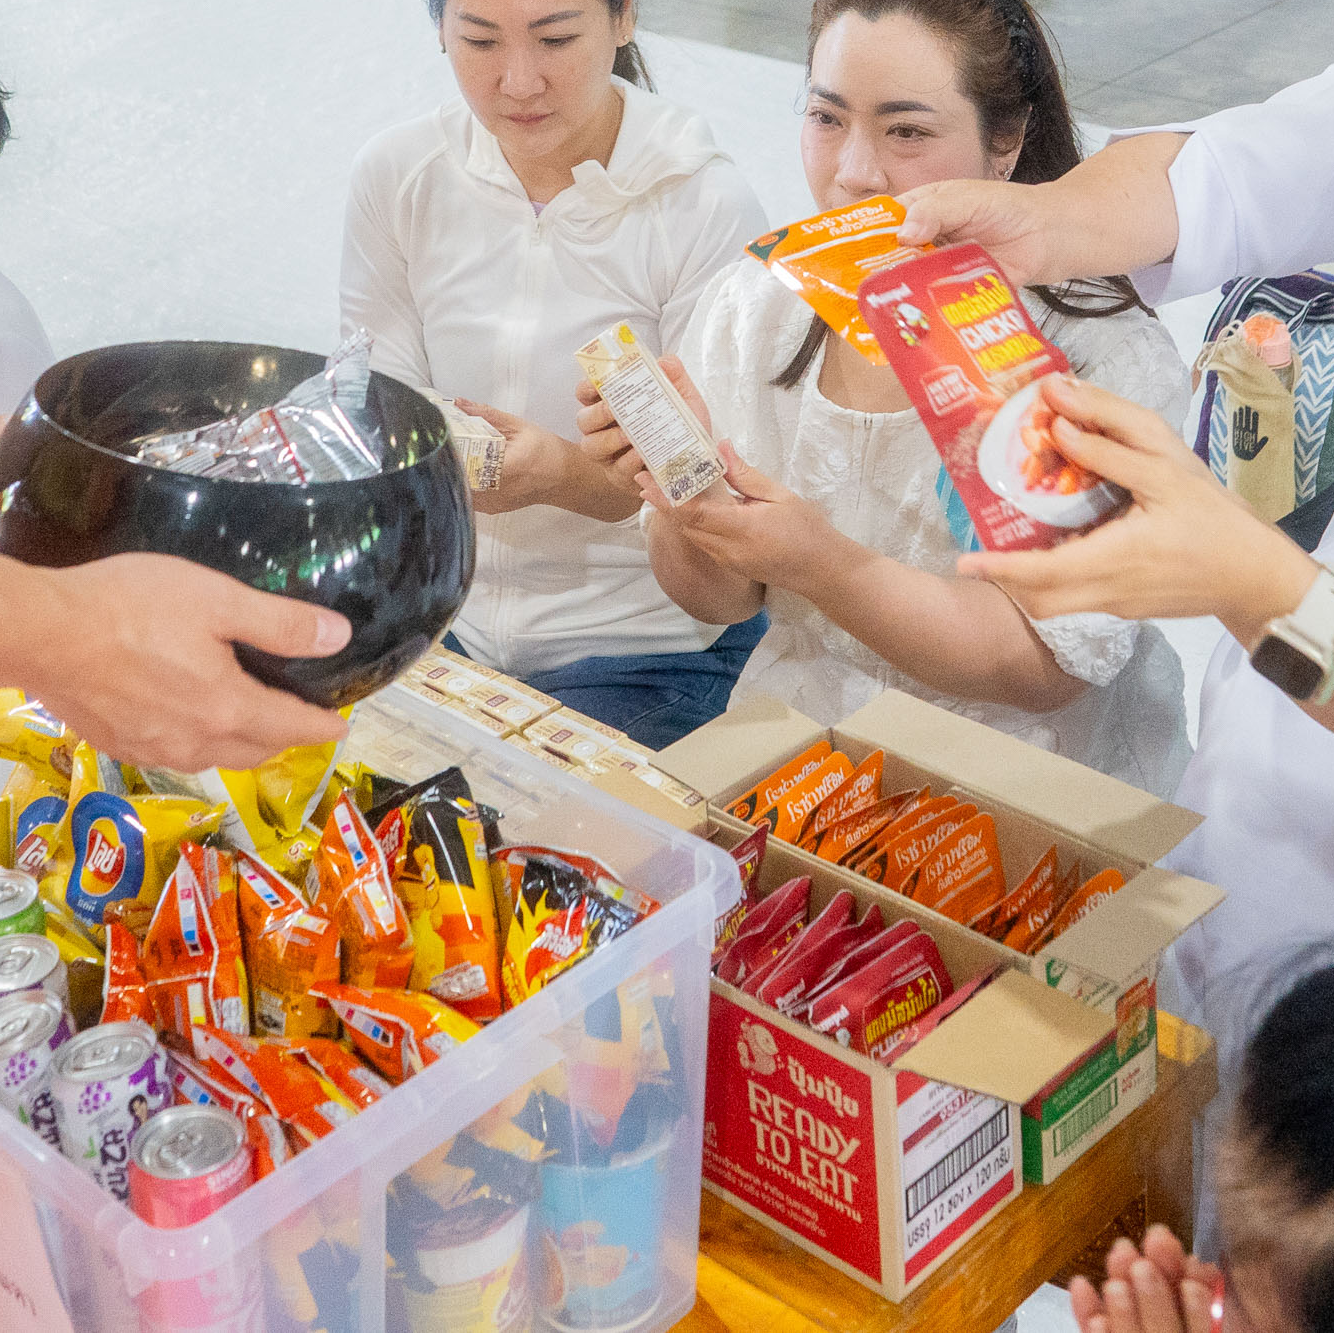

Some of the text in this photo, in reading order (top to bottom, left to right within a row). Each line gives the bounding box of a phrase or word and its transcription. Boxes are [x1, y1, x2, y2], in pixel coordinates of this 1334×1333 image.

[1234, 430, 1257, 443] HIGH
[1234, 439, 1255, 452] FIVE
[747, 1078, 861, 1165] READY
[749, 1116, 791, 1165] TO
[800, 1145, 859, 1204] EAT
[934, 1204, 945, 1227] 12
[975, 1164, 992, 1191] 120
